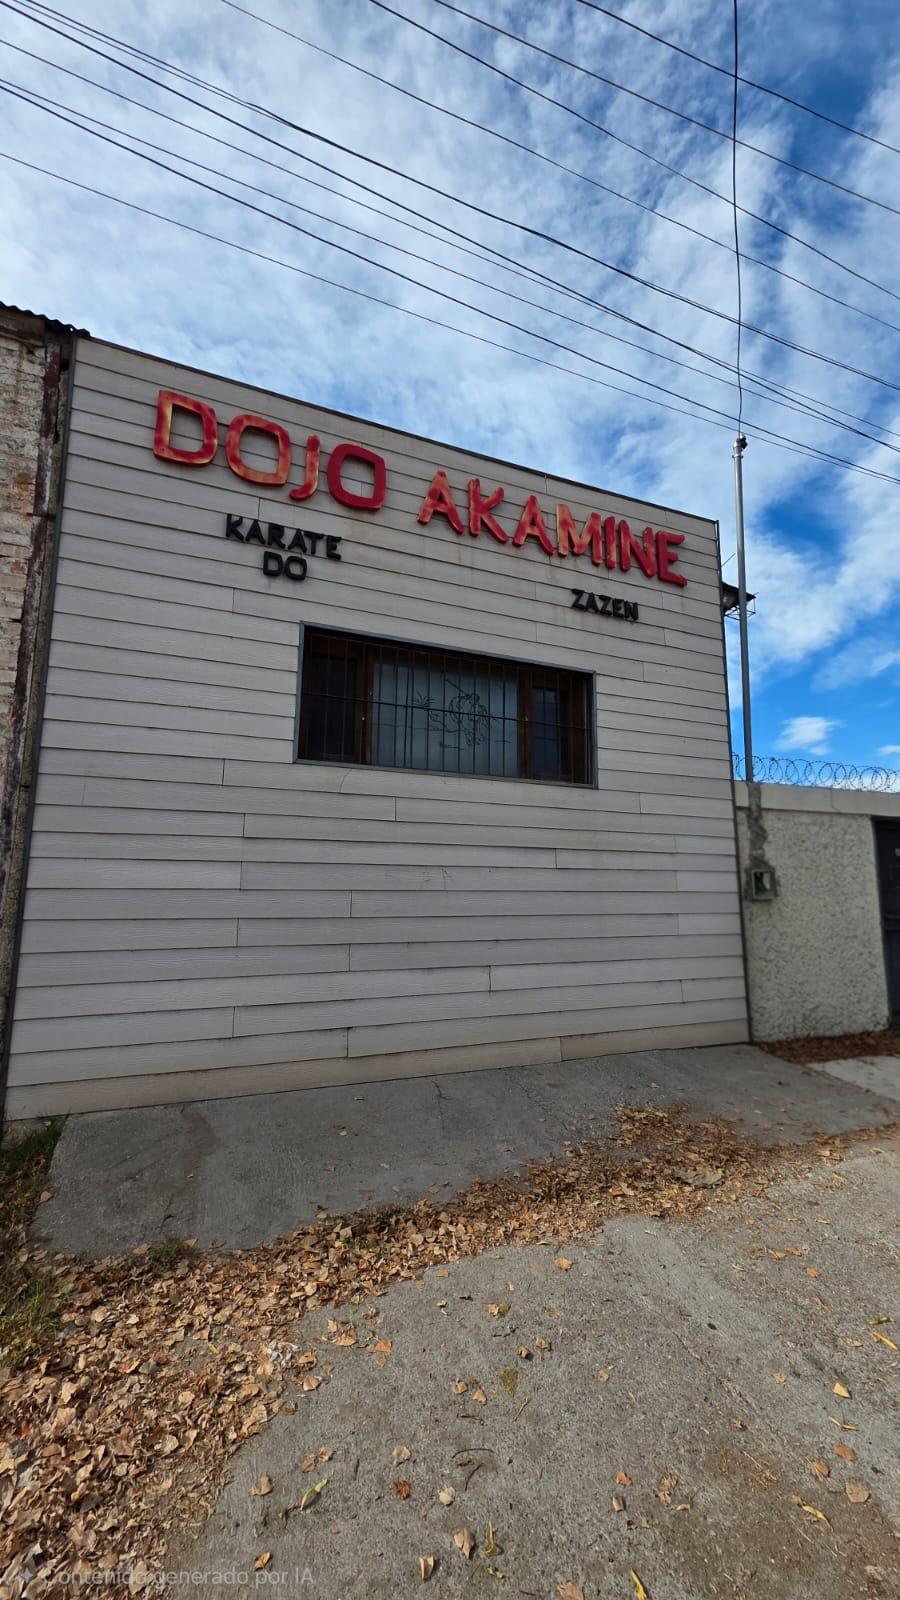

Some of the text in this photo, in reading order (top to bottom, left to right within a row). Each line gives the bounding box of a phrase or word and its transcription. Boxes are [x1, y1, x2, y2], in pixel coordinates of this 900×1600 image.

[153, 389, 688, 588] DOJO AKAMINE
[225, 513, 342, 560] KARATE
[262, 550, 308, 581] DO
[570, 588, 640, 622] ZAZEN
